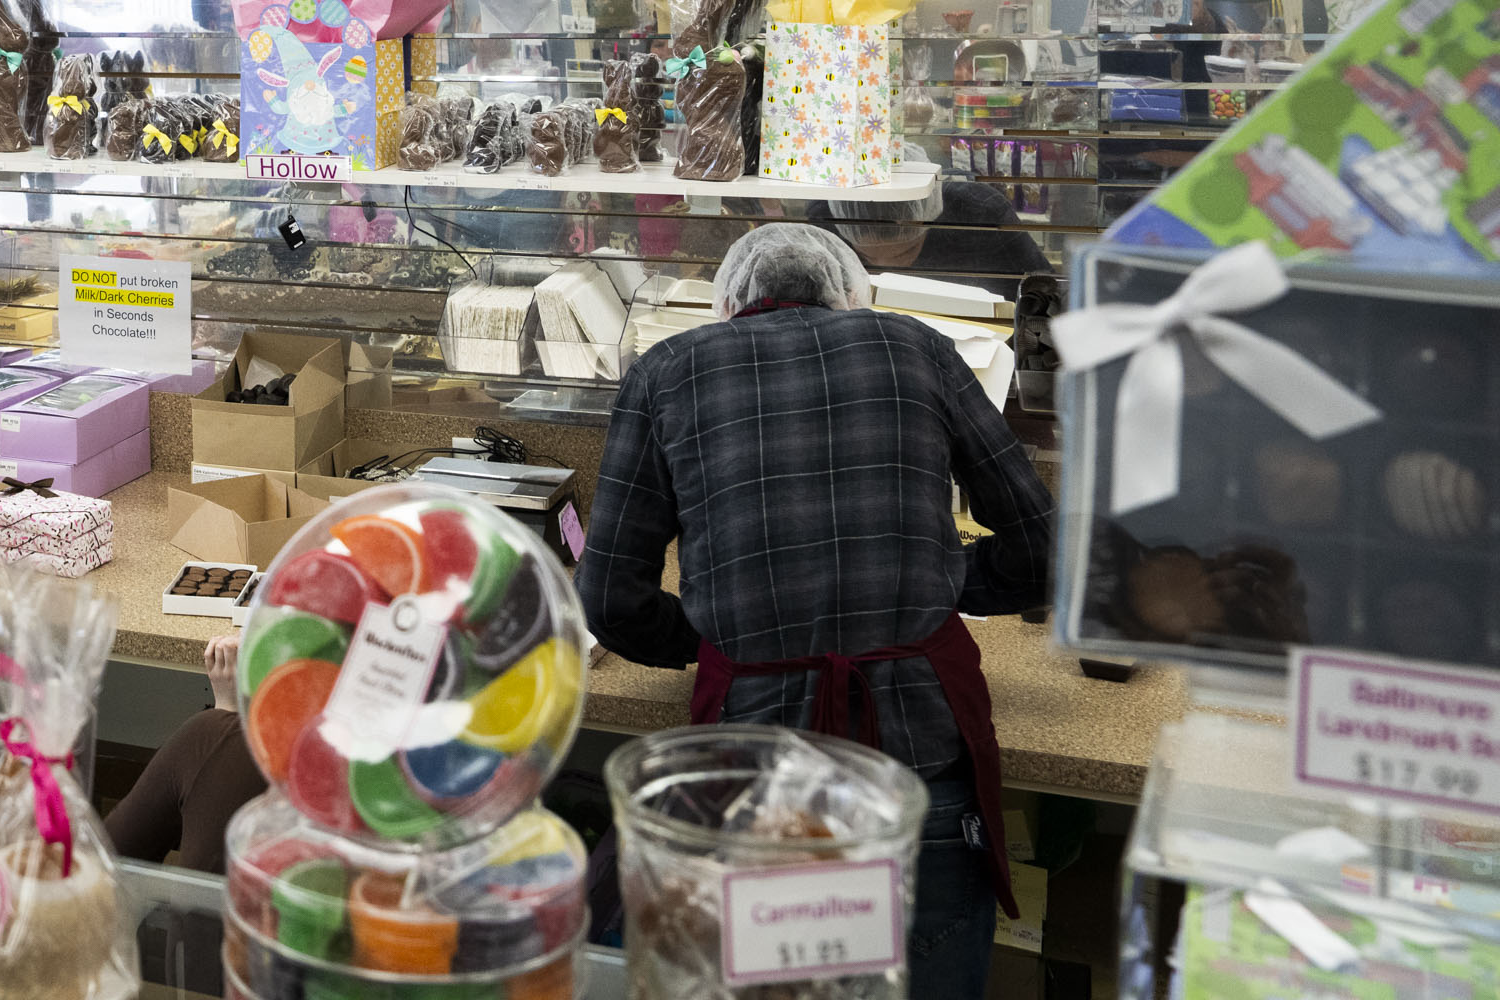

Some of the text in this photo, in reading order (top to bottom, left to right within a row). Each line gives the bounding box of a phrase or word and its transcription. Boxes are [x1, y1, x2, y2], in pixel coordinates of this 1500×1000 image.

[260, 157, 338, 179] Hollow
[72, 271, 178, 288] DO NOT put broken
[75, 289, 174, 306] Milk/Dark Cherries
[94, 307, 153, 322] in Seconds
[92, 324, 156, 340] Chocolate!!!
[1350, 678, 1492, 723] Baltimore
[1317, 707, 1462, 753] Landmark
